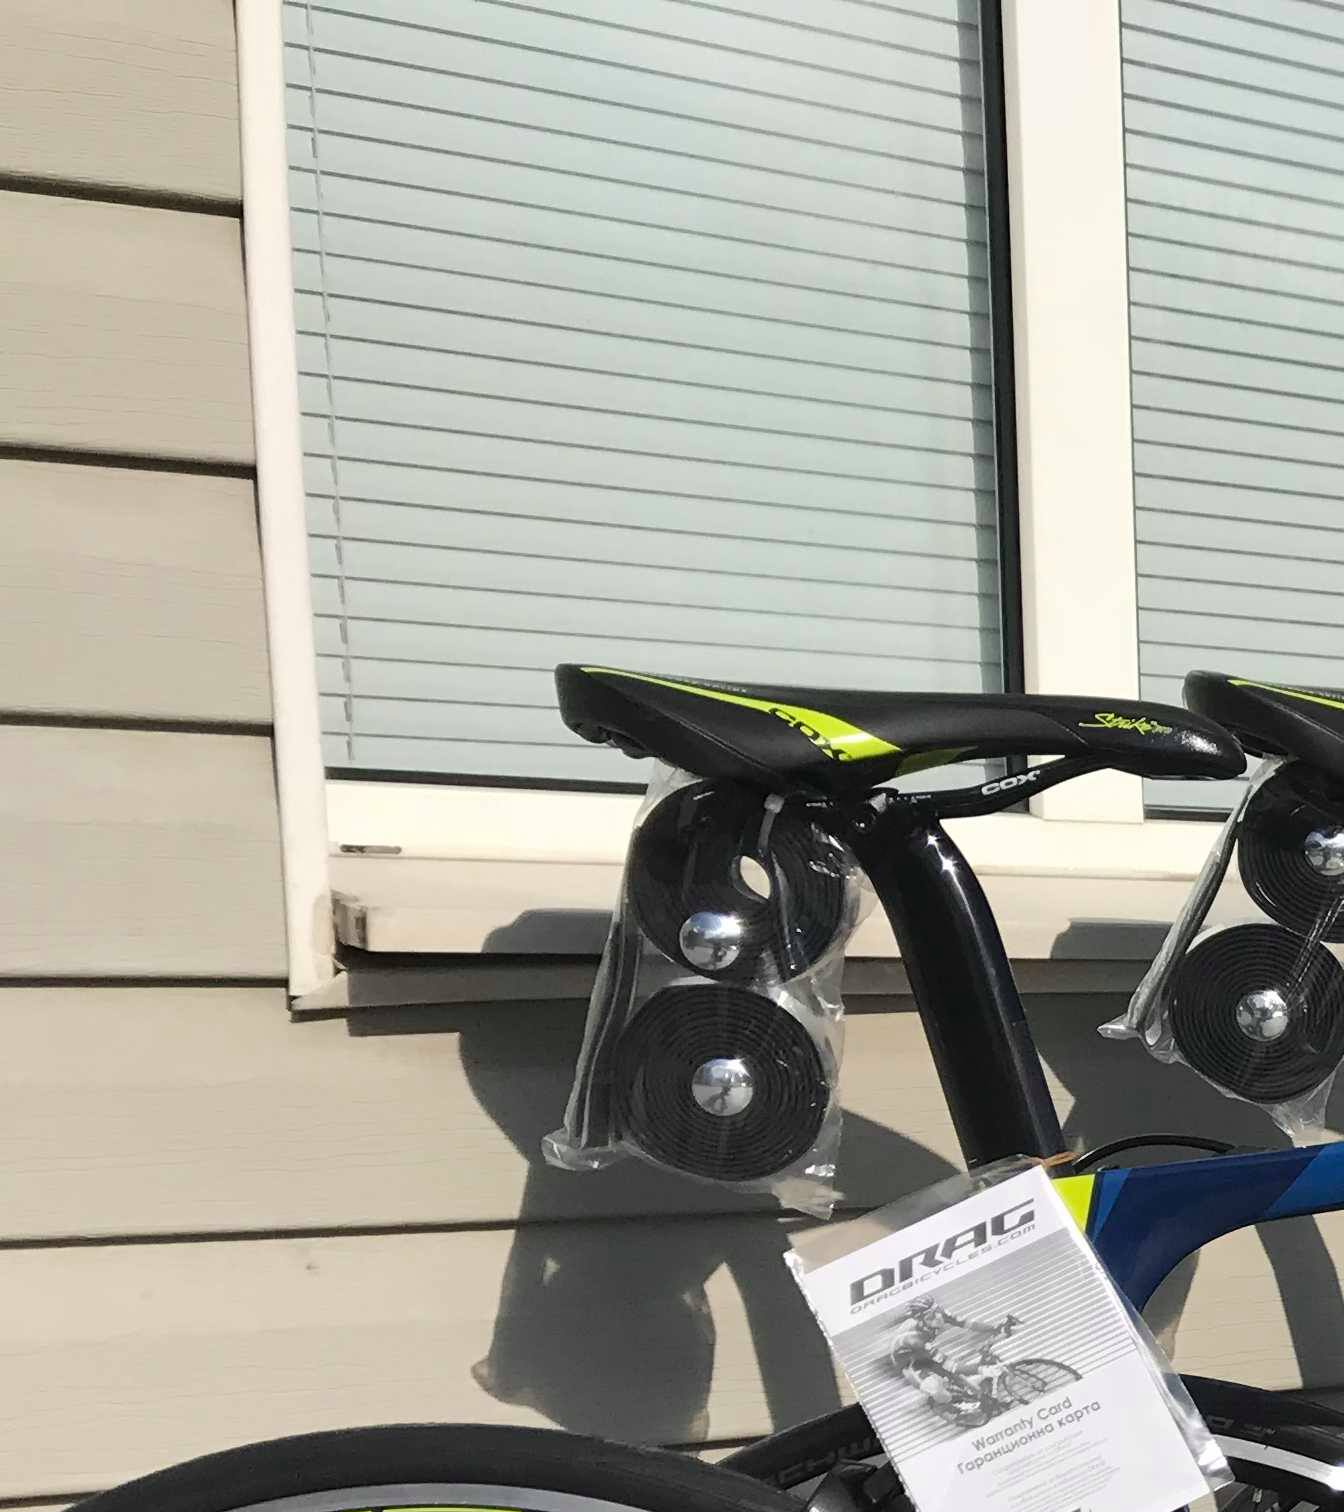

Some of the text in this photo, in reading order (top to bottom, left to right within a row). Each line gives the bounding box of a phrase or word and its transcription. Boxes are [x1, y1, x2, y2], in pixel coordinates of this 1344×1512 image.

[980, 769, 1041, 797] COX
[849, 1196, 1036, 1306] DRAG
[956, 1399, 1102, 1476] Гаранционна карта
[971, 1396, 1074, 1453] Warranty Card
